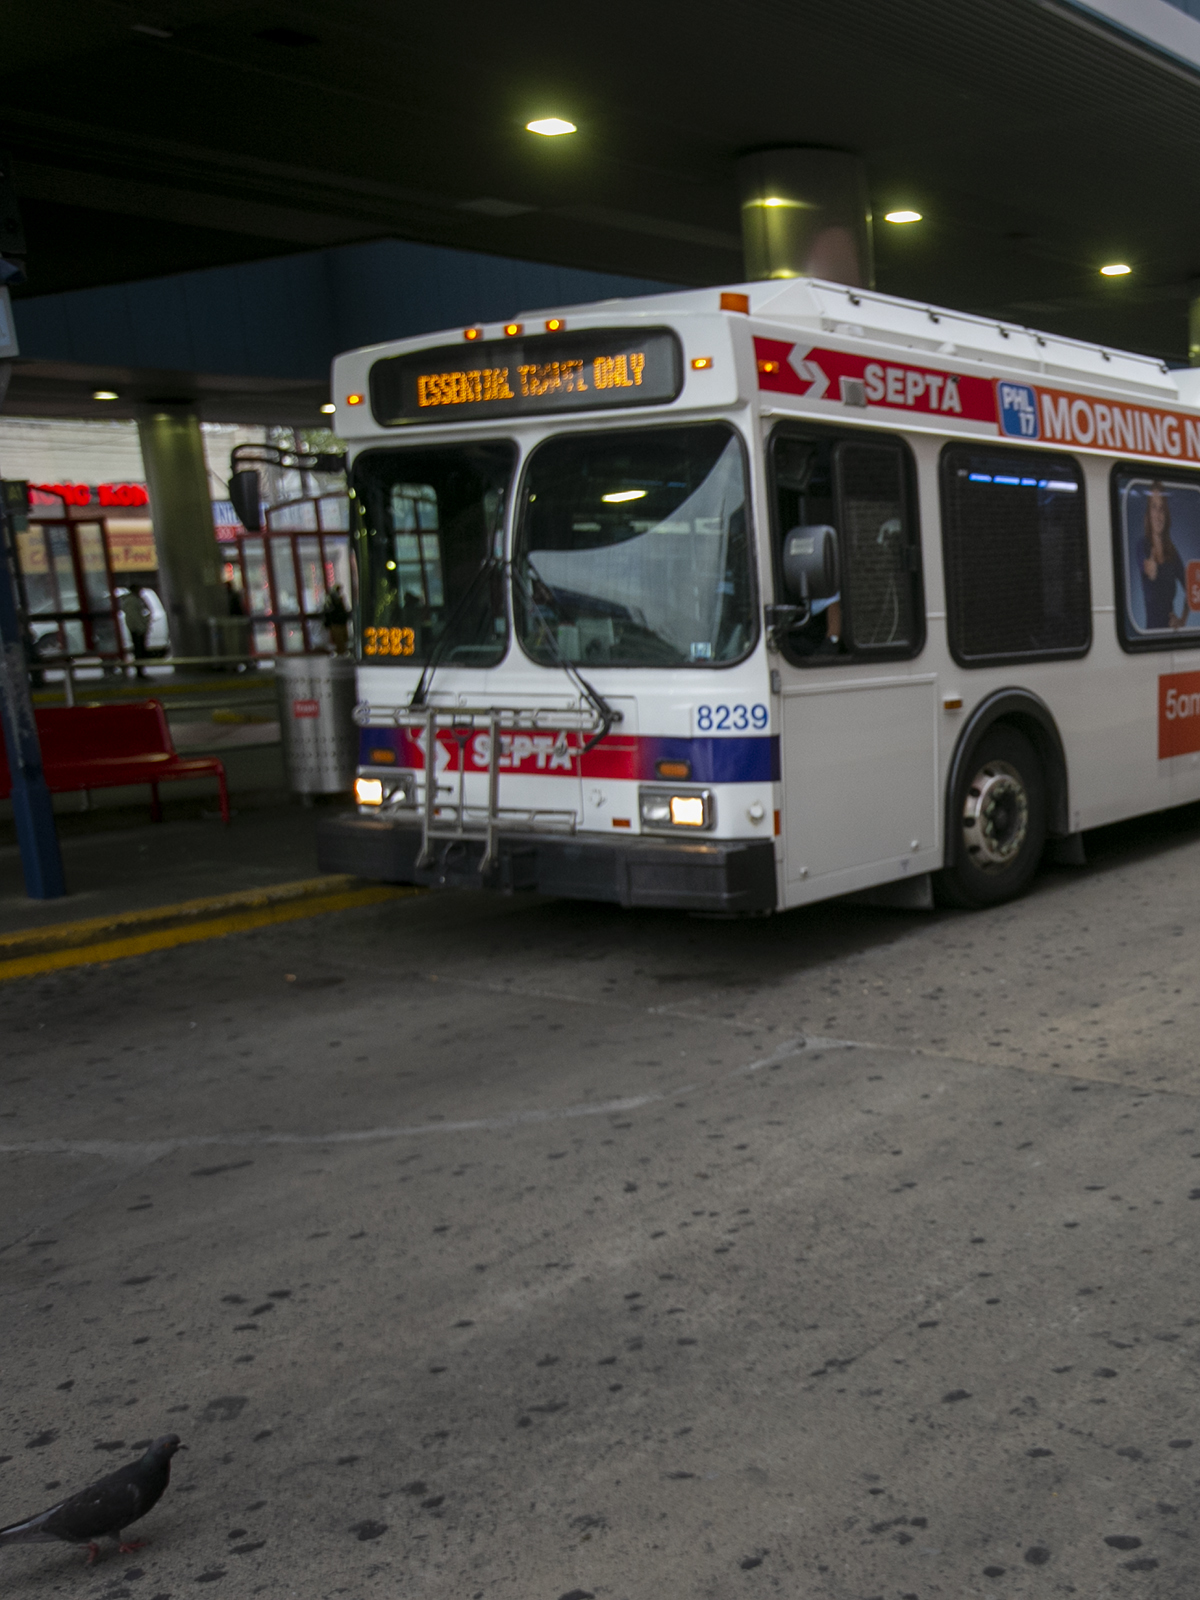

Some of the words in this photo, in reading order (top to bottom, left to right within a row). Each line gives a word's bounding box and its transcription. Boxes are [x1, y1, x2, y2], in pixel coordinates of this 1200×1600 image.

[417, 367, 515, 407] ESSENTIAL
[593, 352, 645, 390] ONLY
[864, 363, 962, 414] SEPTA
[1001, 385, 1035, 413] PHL
[1018, 411, 1035, 436] 17
[1040, 393, 1182, 457] MORNING
[697, 703, 769, 731] 8239
[471, 734, 573, 771] SEPTA
